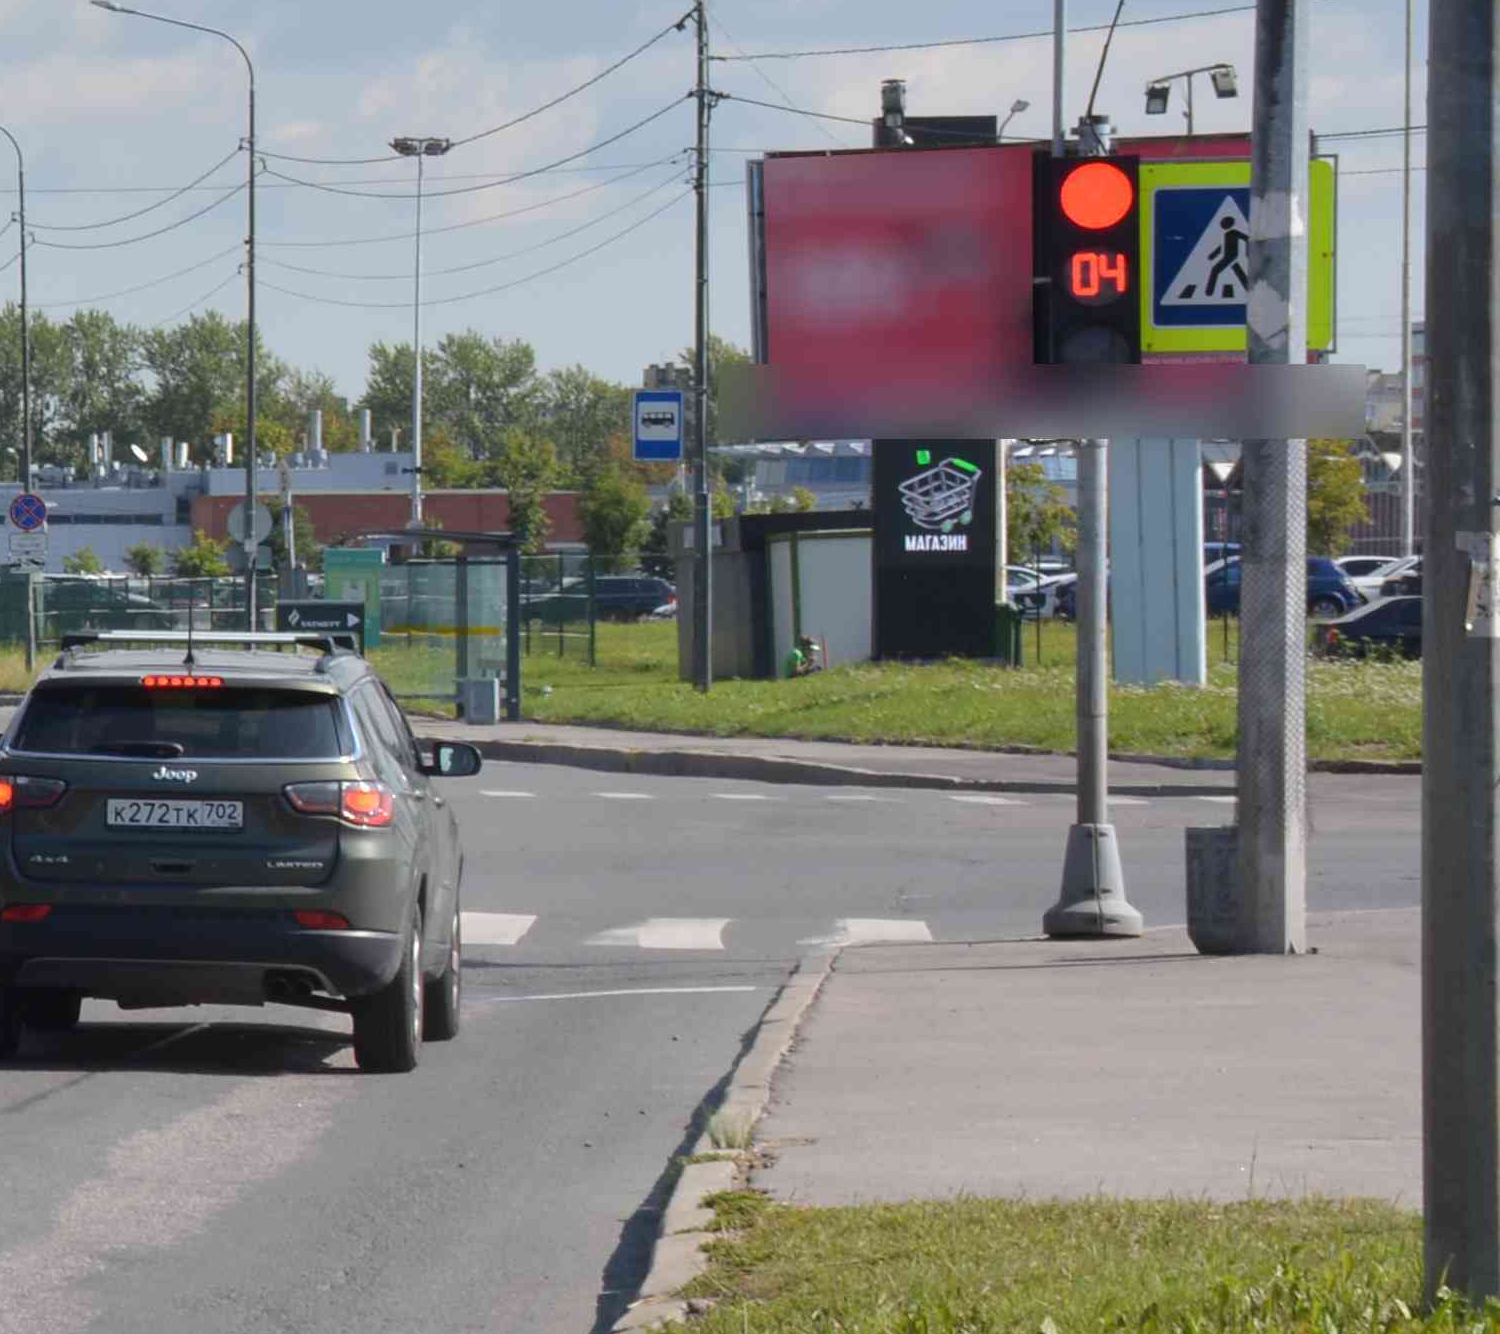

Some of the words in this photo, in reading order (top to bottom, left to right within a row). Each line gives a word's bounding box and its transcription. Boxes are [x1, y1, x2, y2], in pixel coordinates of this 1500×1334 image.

[1072, 252, 1125, 296] 04
[904, 534, 967, 551] МАГАЗИН
[153, 765, 198, 784] Jeep
